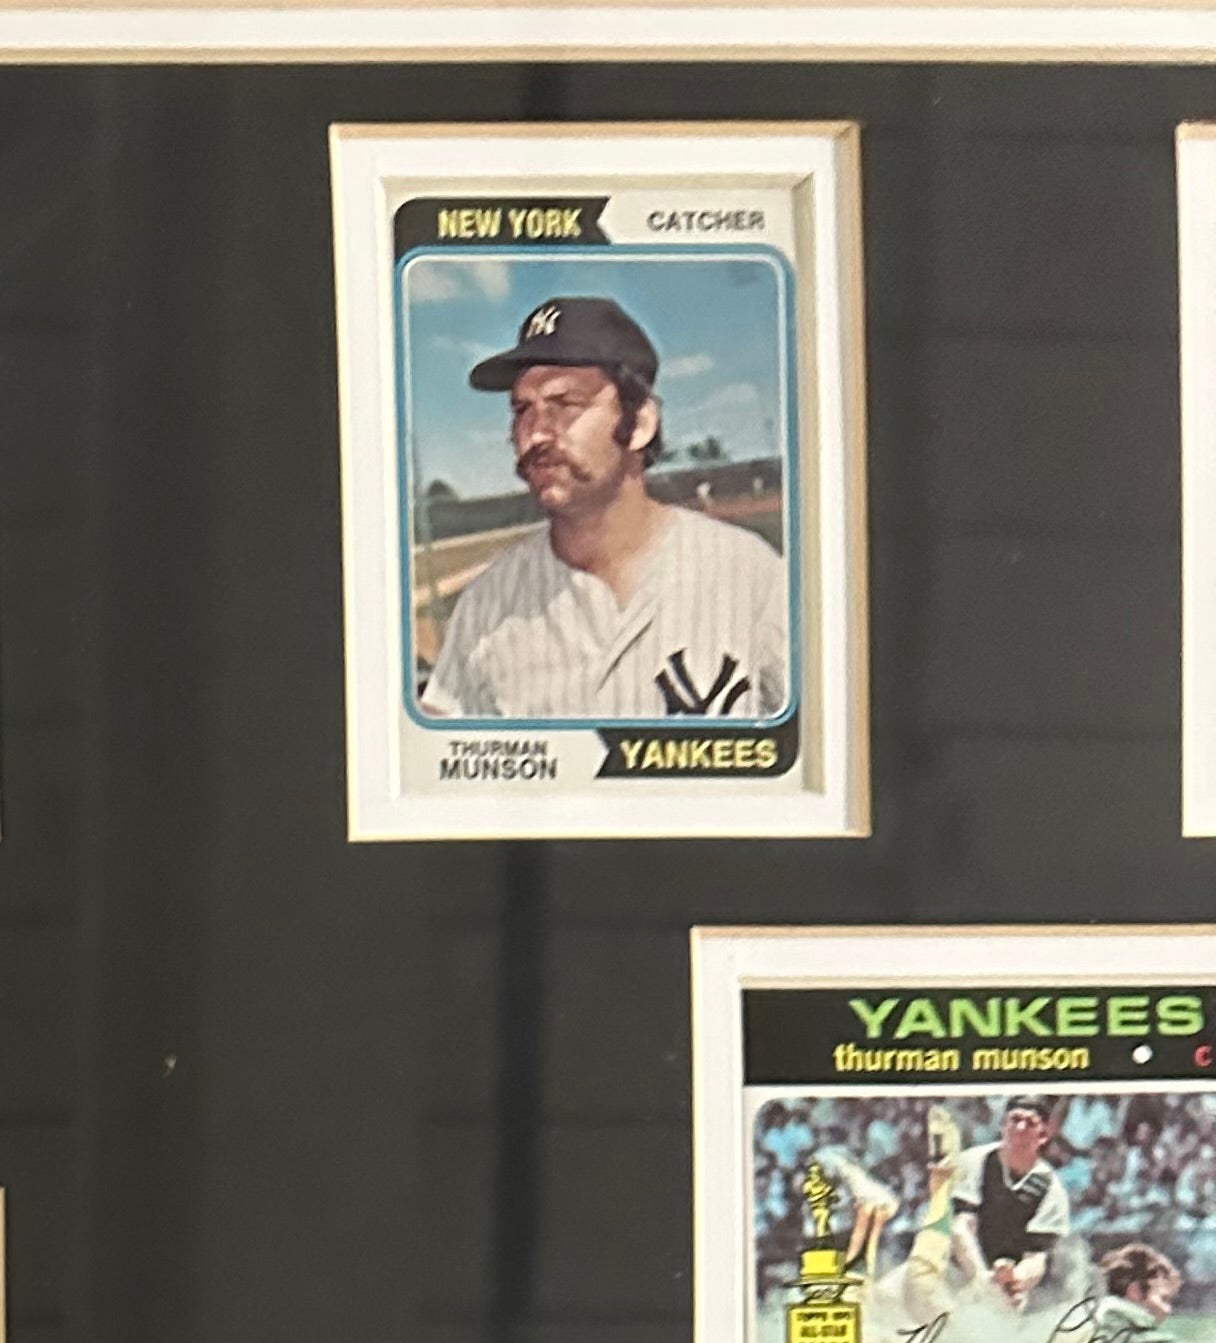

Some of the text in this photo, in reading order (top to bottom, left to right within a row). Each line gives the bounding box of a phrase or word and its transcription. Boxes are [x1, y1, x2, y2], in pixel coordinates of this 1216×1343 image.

[437, 207, 583, 239] NEW YORK
[646, 210, 766, 233] CATCHER
[449, 740, 549, 756] THURMAN
[620, 738, 779, 769] YANKEES
[438, 757, 558, 781] MUNSON
[848, 995, 1205, 1040] YANKEES
[833, 1041, 961, 1072] thurman
[971, 1045, 1090, 1071] munson
